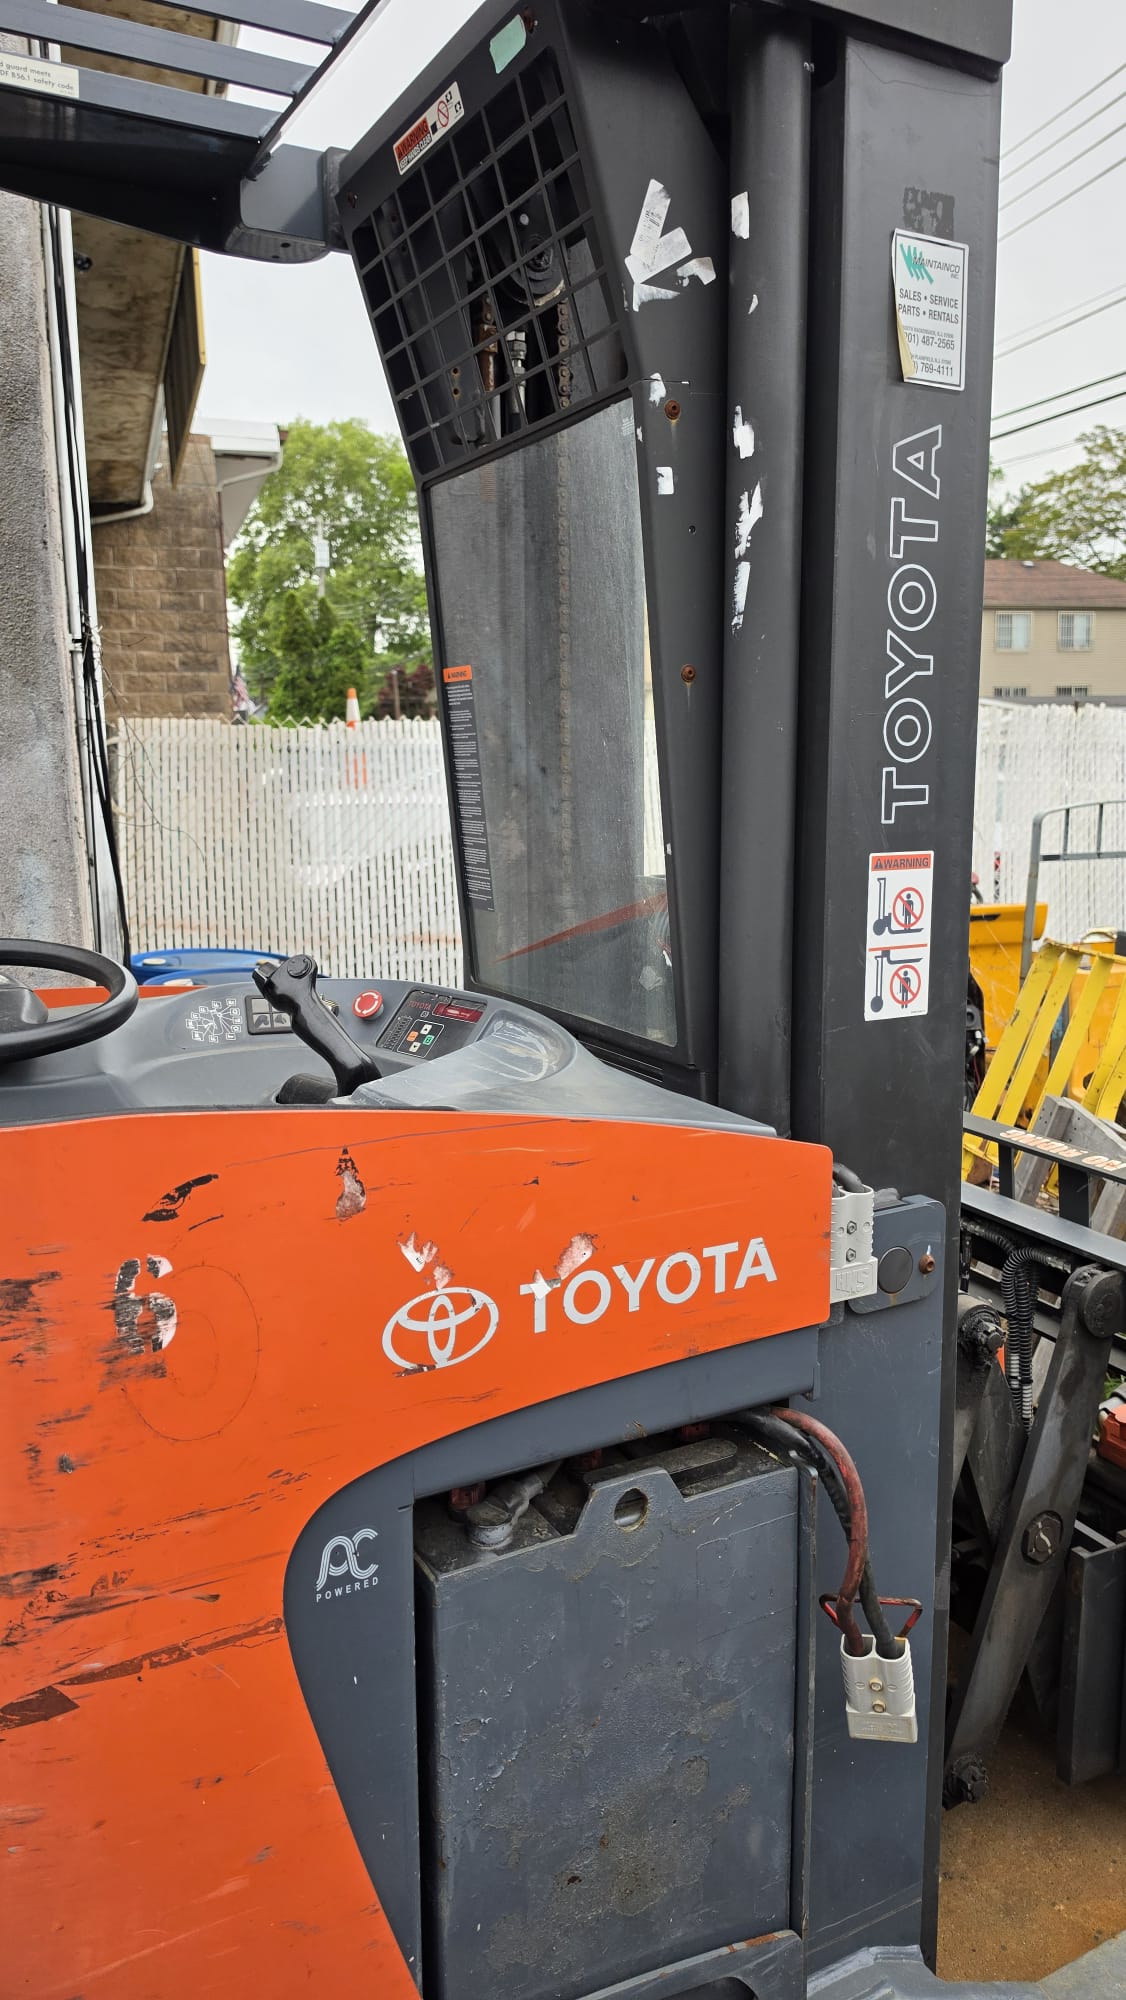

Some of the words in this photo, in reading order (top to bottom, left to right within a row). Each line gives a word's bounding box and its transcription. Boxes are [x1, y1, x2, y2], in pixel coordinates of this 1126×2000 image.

[5, 62, 28, 72] guard
[33, 77, 55, 88] safety
[57, 82, 74, 90] code
[912, 255, 961, 274] MAINTAINCO
[899, 287, 922, 302] SALES
[929, 294, 959, 309] SERVICE
[898, 303, 921, 317] PARTS
[928, 309, 959, 325] RENTALS
[921, 335, 955, 351] 487-2565
[920, 361, 953, 377] 769-4111
[881, 424, 942, 824] TOYOTA
[883, 857, 929, 869] WARNING
[519, 1237, 778, 1334] TOYOTA
[316, 1576, 379, 1603] POWERED
